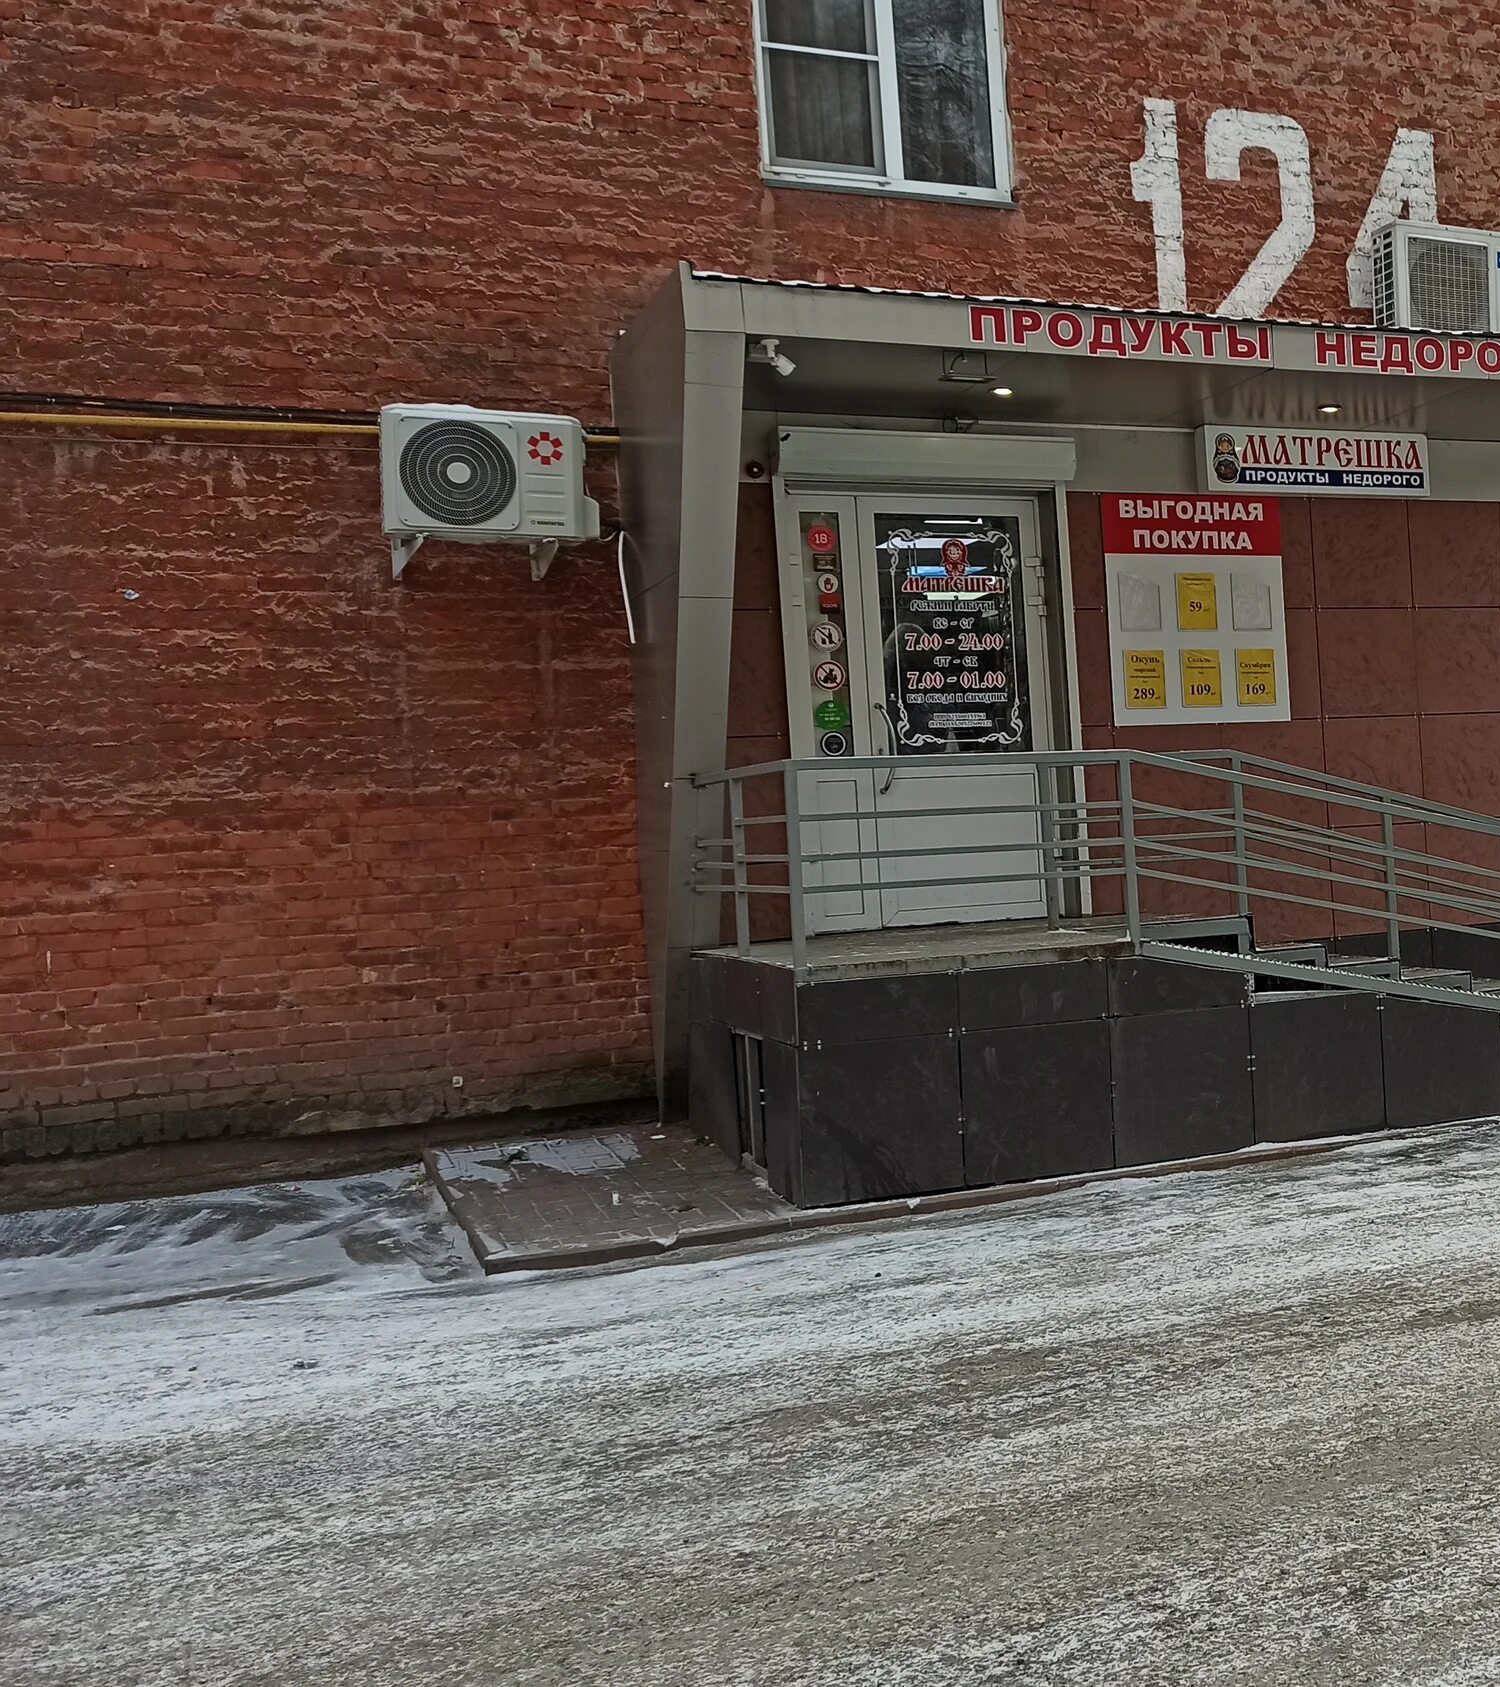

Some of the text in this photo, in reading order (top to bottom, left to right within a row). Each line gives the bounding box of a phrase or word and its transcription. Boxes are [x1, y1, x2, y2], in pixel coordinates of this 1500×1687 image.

[967, 304, 1272, 361] ПРОДУКТЫ
[1241, 434, 1424, 470] МАТРЕШКА
[1245, 469, 1421, 487] ПРОДУКТЫ НЕДОРОГО
[1118, 499, 1264, 523] ВЫГОДНАЯ
[1133, 529, 1253, 550] ПОКУПКА
[1189, 601, 1202, 612] 59
[904, 633, 942, 650] 7.00
[958, 633, 1004, 650] 24.00
[907, 671, 945, 689] 7.00
[960, 671, 1006, 689] 01.00
[1133, 688, 1155, 700] 289
[1190, 684, 1211, 696] 109
[1246, 683, 1266, 696] 169
